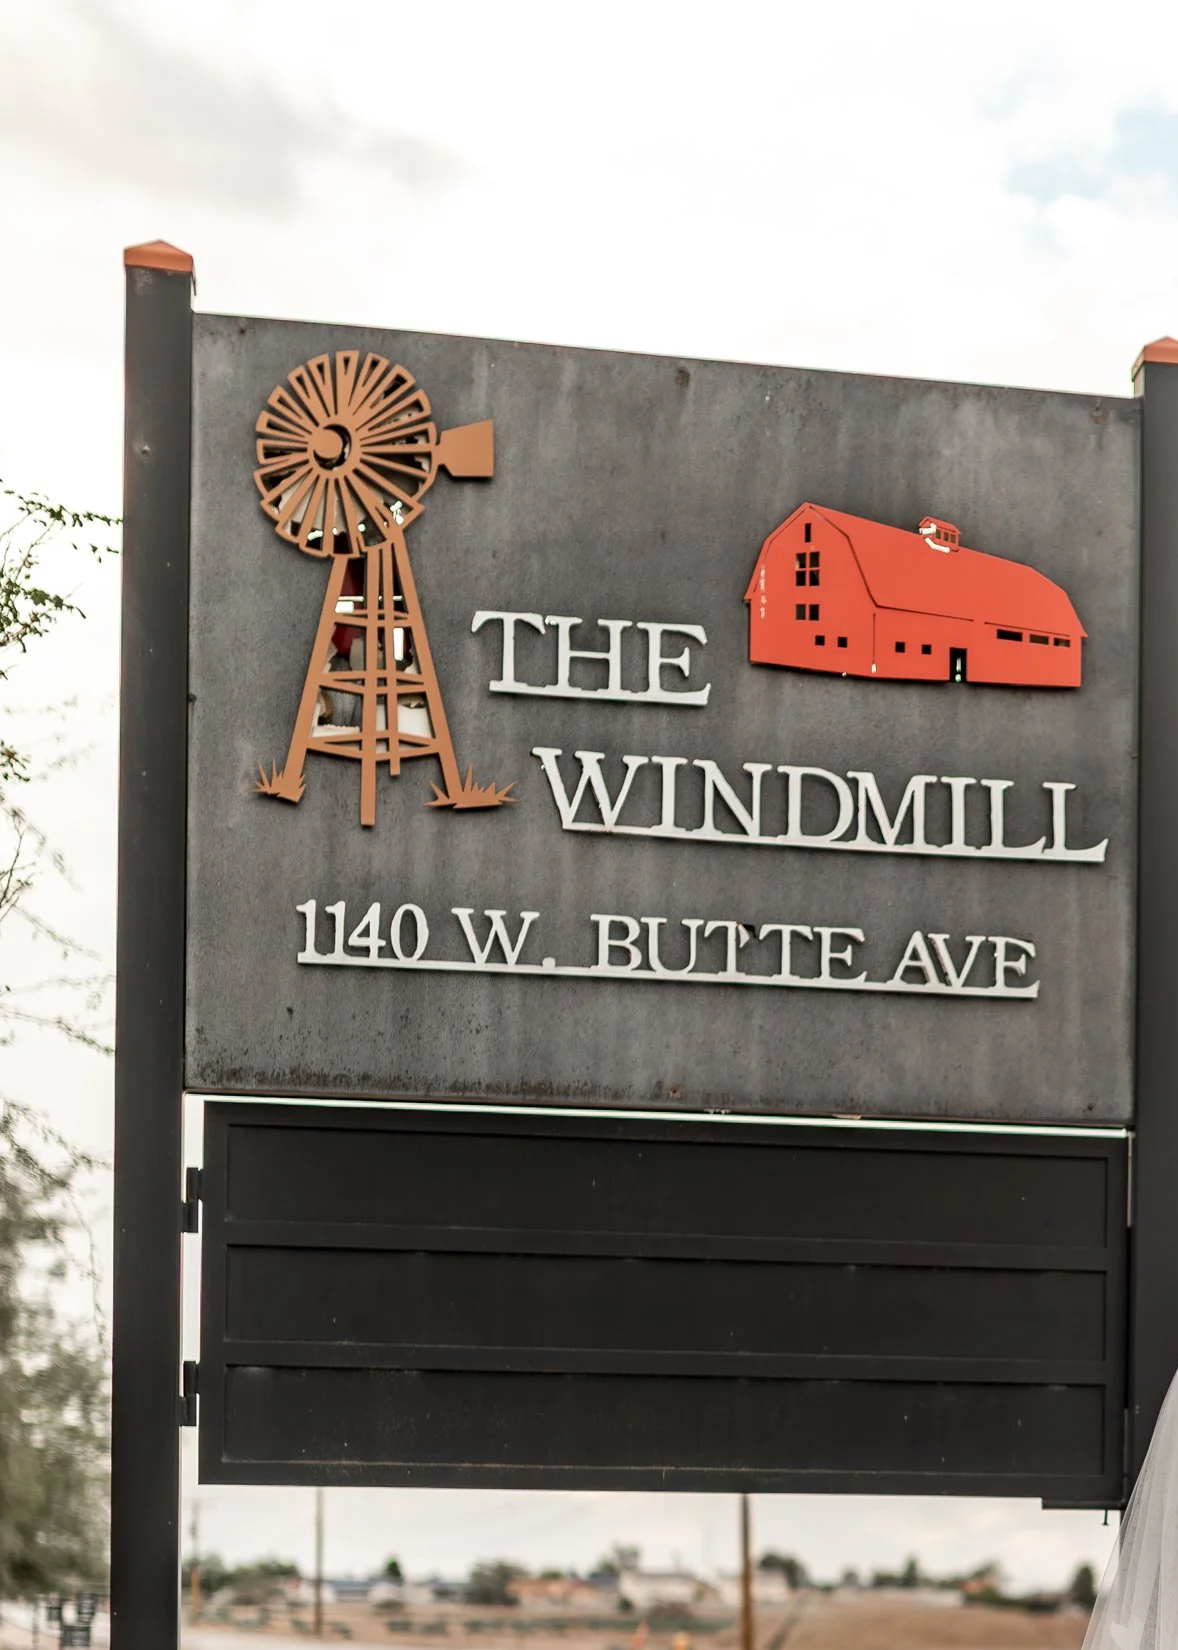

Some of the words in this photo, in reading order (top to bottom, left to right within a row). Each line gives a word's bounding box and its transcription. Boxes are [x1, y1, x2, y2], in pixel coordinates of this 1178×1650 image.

[471, 610, 712, 706] THE
[532, 747, 1109, 862] WINDMILL
[296, 899, 430, 966] 1140
[451, 907, 556, 972] W.
[590, 913, 867, 986] BUTTE
[885, 930, 1041, 998] AVE
